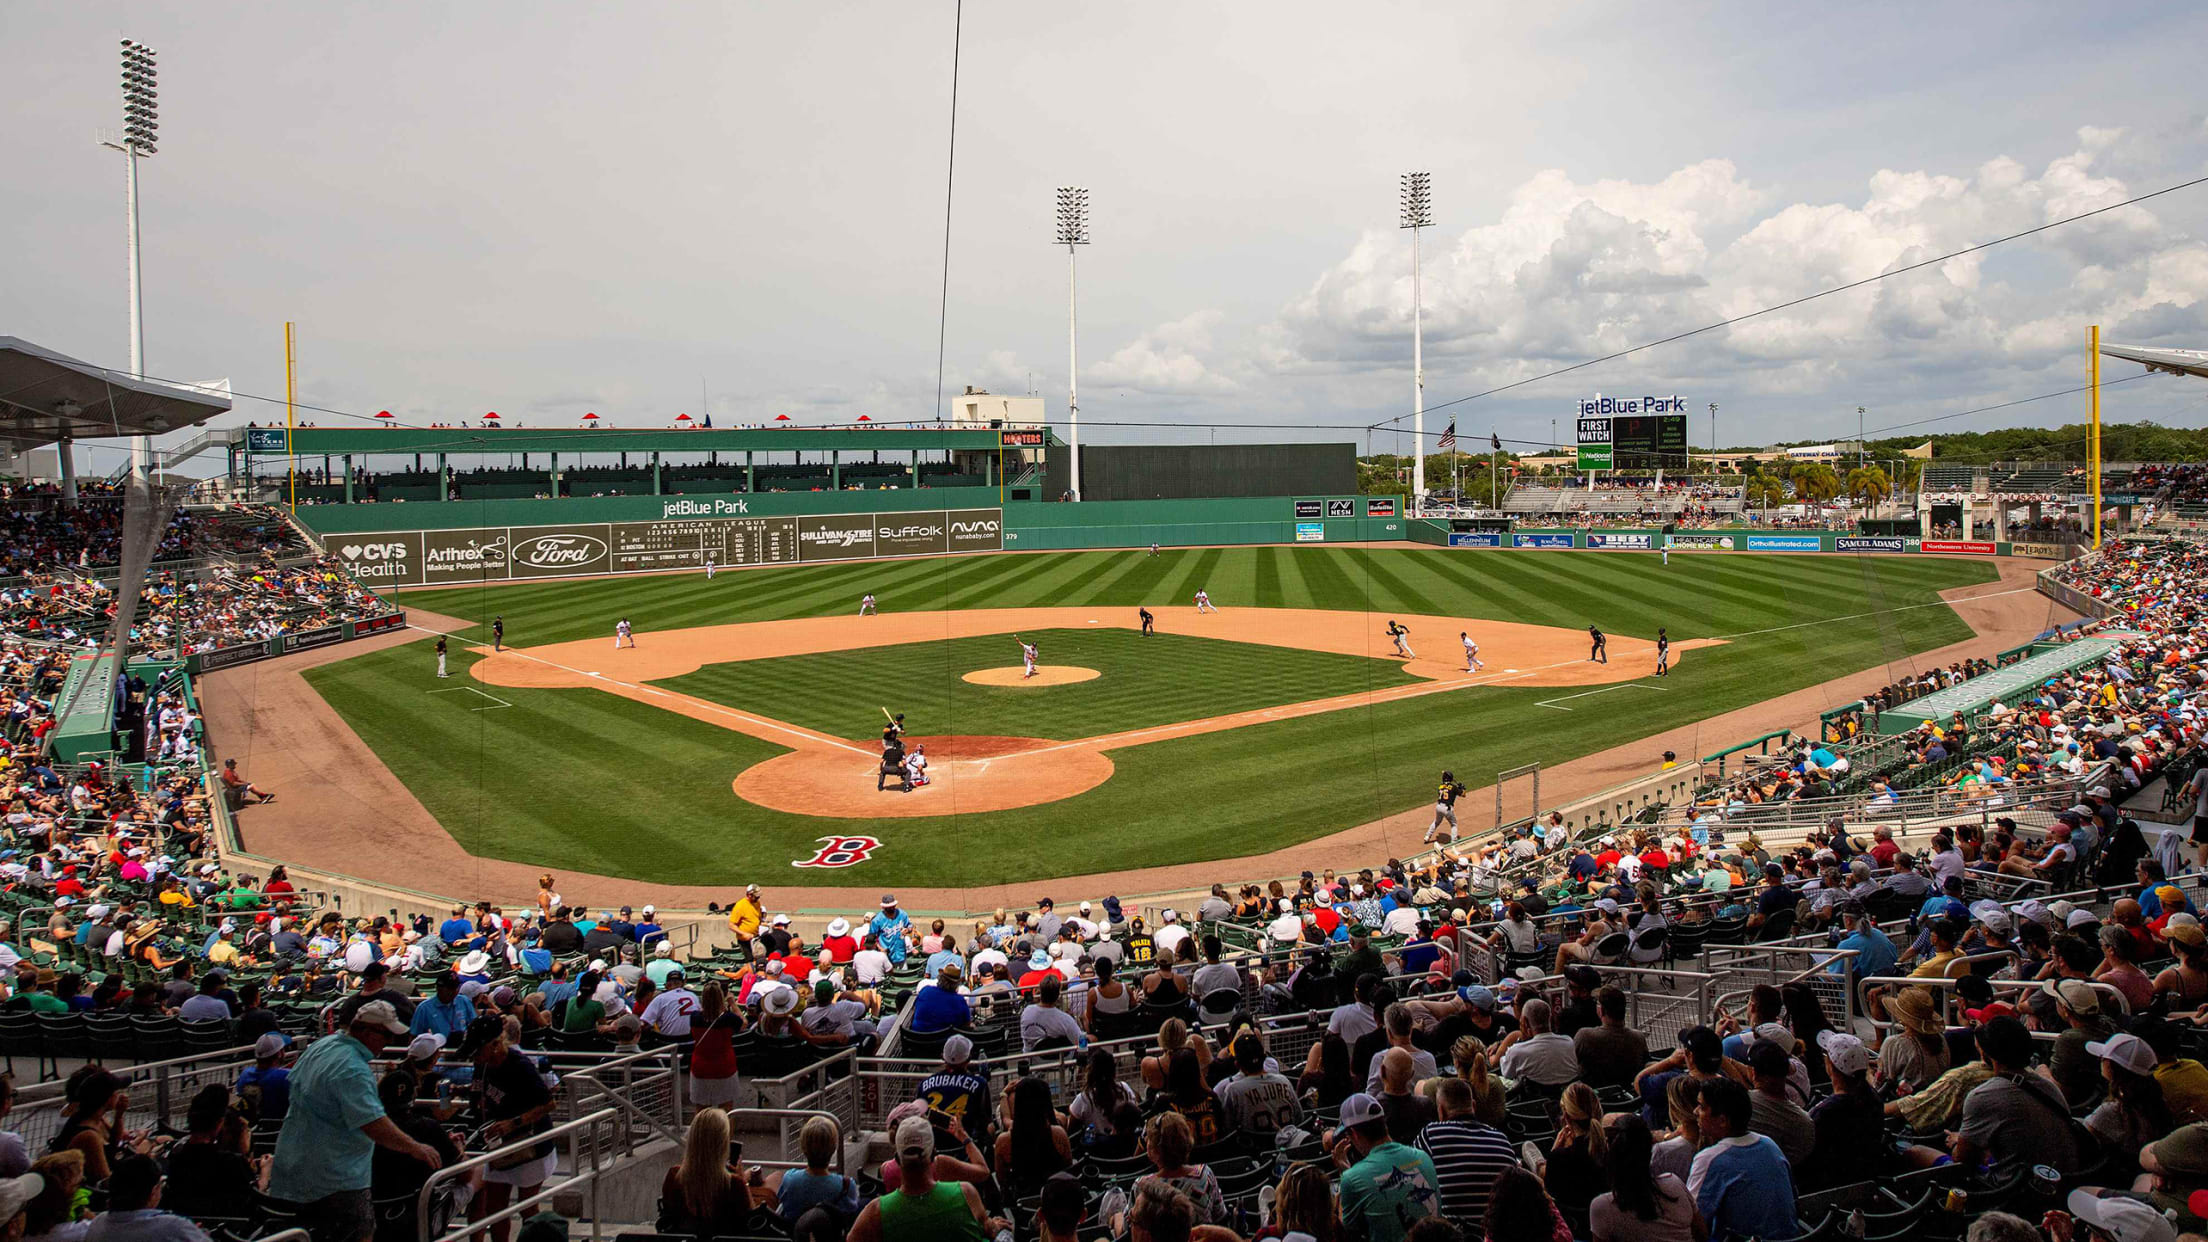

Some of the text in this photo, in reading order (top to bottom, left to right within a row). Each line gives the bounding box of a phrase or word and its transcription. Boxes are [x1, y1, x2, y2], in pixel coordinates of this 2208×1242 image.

[1580, 395, 1684, 418] jetBlue Park
[1581, 420, 1607, 430] FIRST
[1003, 434, 1041, 444] HOOTERS
[1578, 430, 1610, 441] WATCH
[663, 499, 748, 519] jetBlue Park
[652, 521, 712, 529] AMERICAN
[879, 525, 943, 538] Suffolk
[800, 529, 873, 541] SULLIVAN TIRE
[955, 532, 995, 540] nunababy.com
[1905, 538, 1920, 546] 380
[530, 539, 590, 563] Ford
[1838, 539, 1902, 549] SAMUEL ADAMS
[363, 543, 407, 560] CVS
[427, 547, 485, 562] Arthrex
[345, 561, 407, 578] Health
[426, 563, 455, 571] Making
[456, 562, 481, 570] People
[791, 835, 884, 868] B
[1134, 947, 1151, 961] 18
[678, 997, 694, 1017] 2
[922, 1074, 979, 1093] BRUBAKER
[1245, 1083, 1290, 1106] YAJURE
